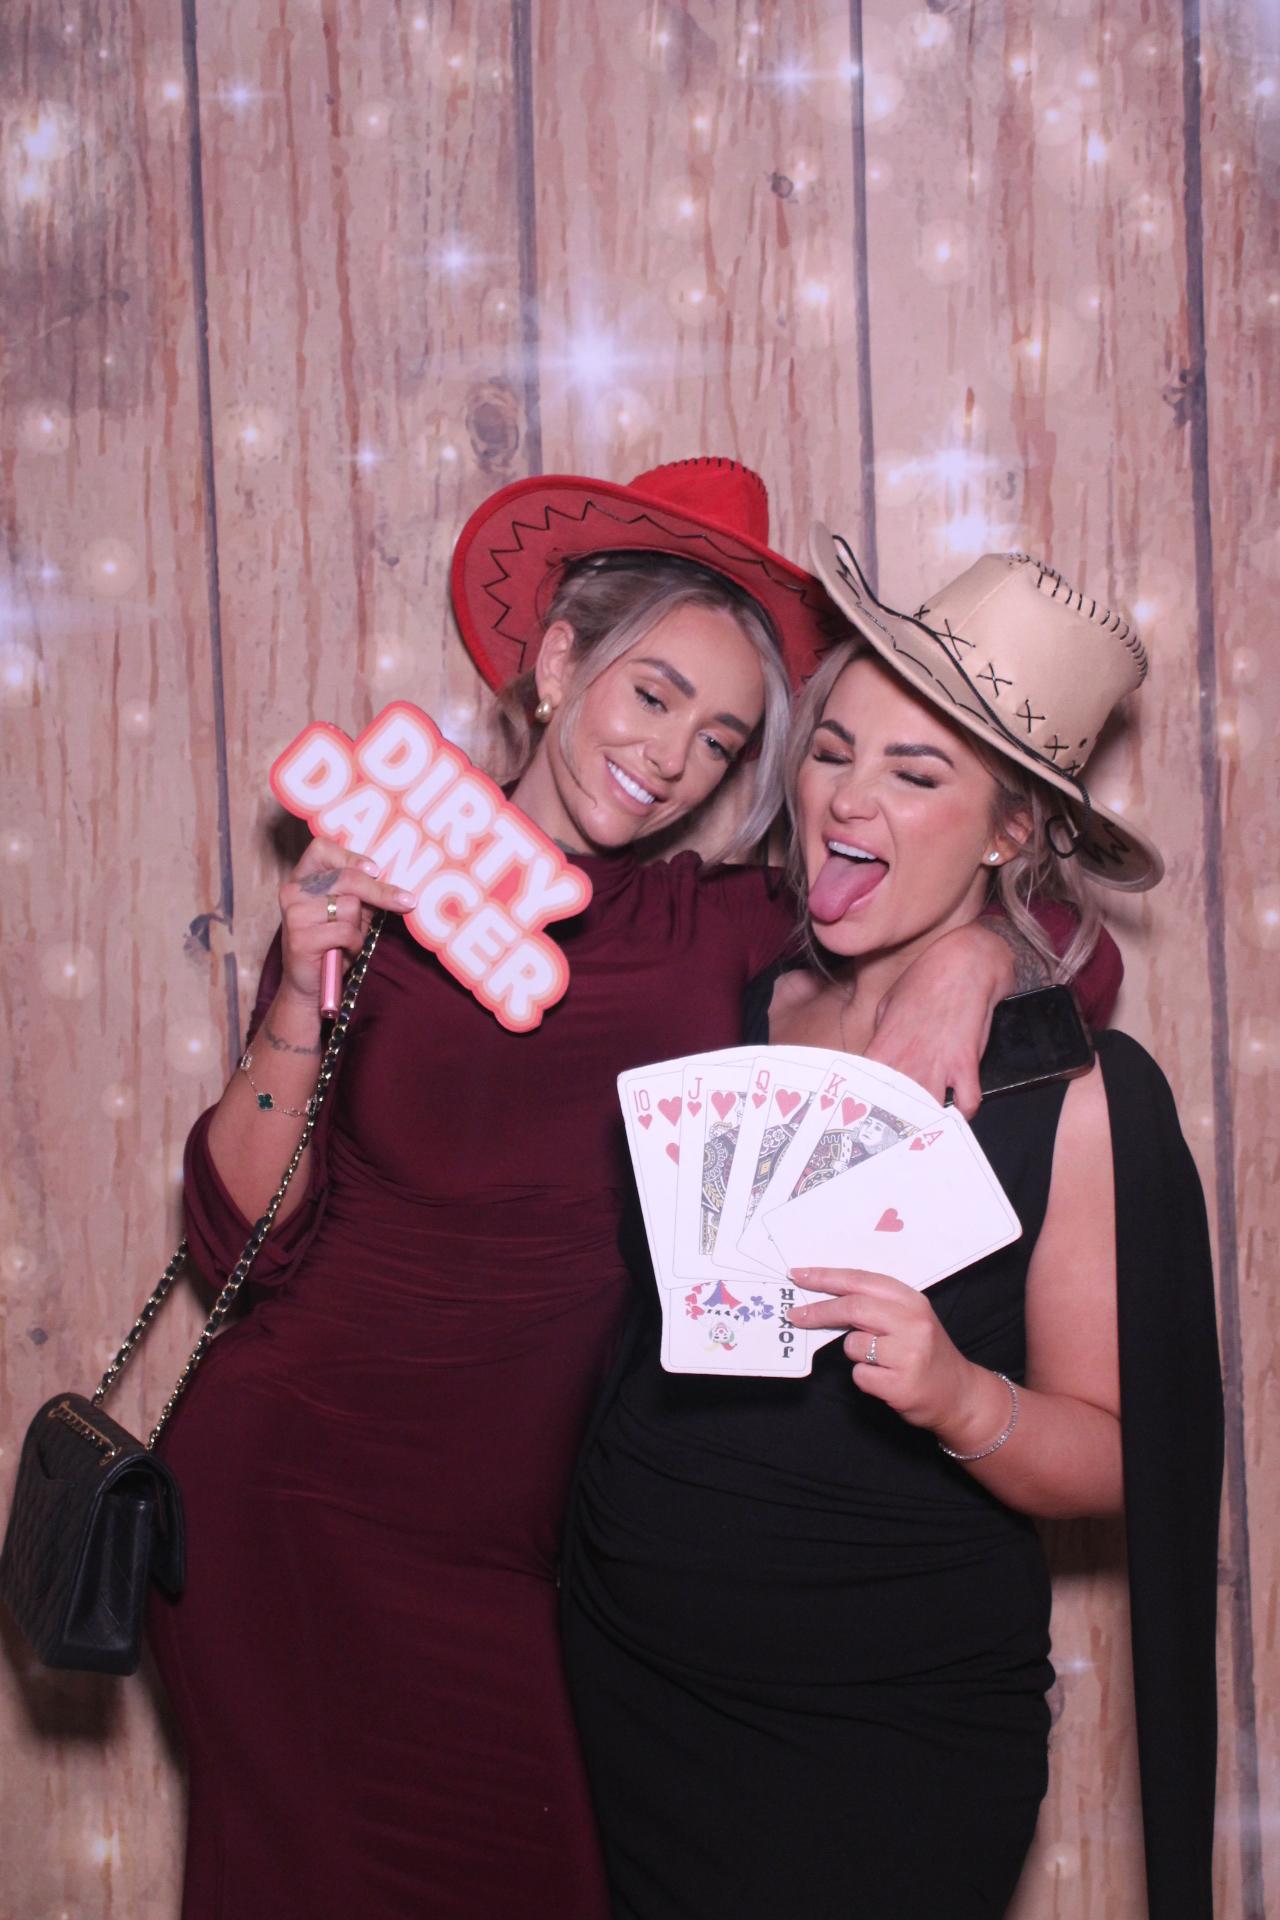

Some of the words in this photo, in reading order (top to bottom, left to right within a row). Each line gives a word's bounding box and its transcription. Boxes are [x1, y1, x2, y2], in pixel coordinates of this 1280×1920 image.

[358, 714, 578, 929] DIRTY
[282, 733, 558, 1018] DANCER
[688, 1077, 703, 1100] J
[755, 1070, 771, 1094] Q
[823, 1072, 847, 1097] K
[633, 1089, 651, 1113] 10
[923, 1130, 944, 1146] A
